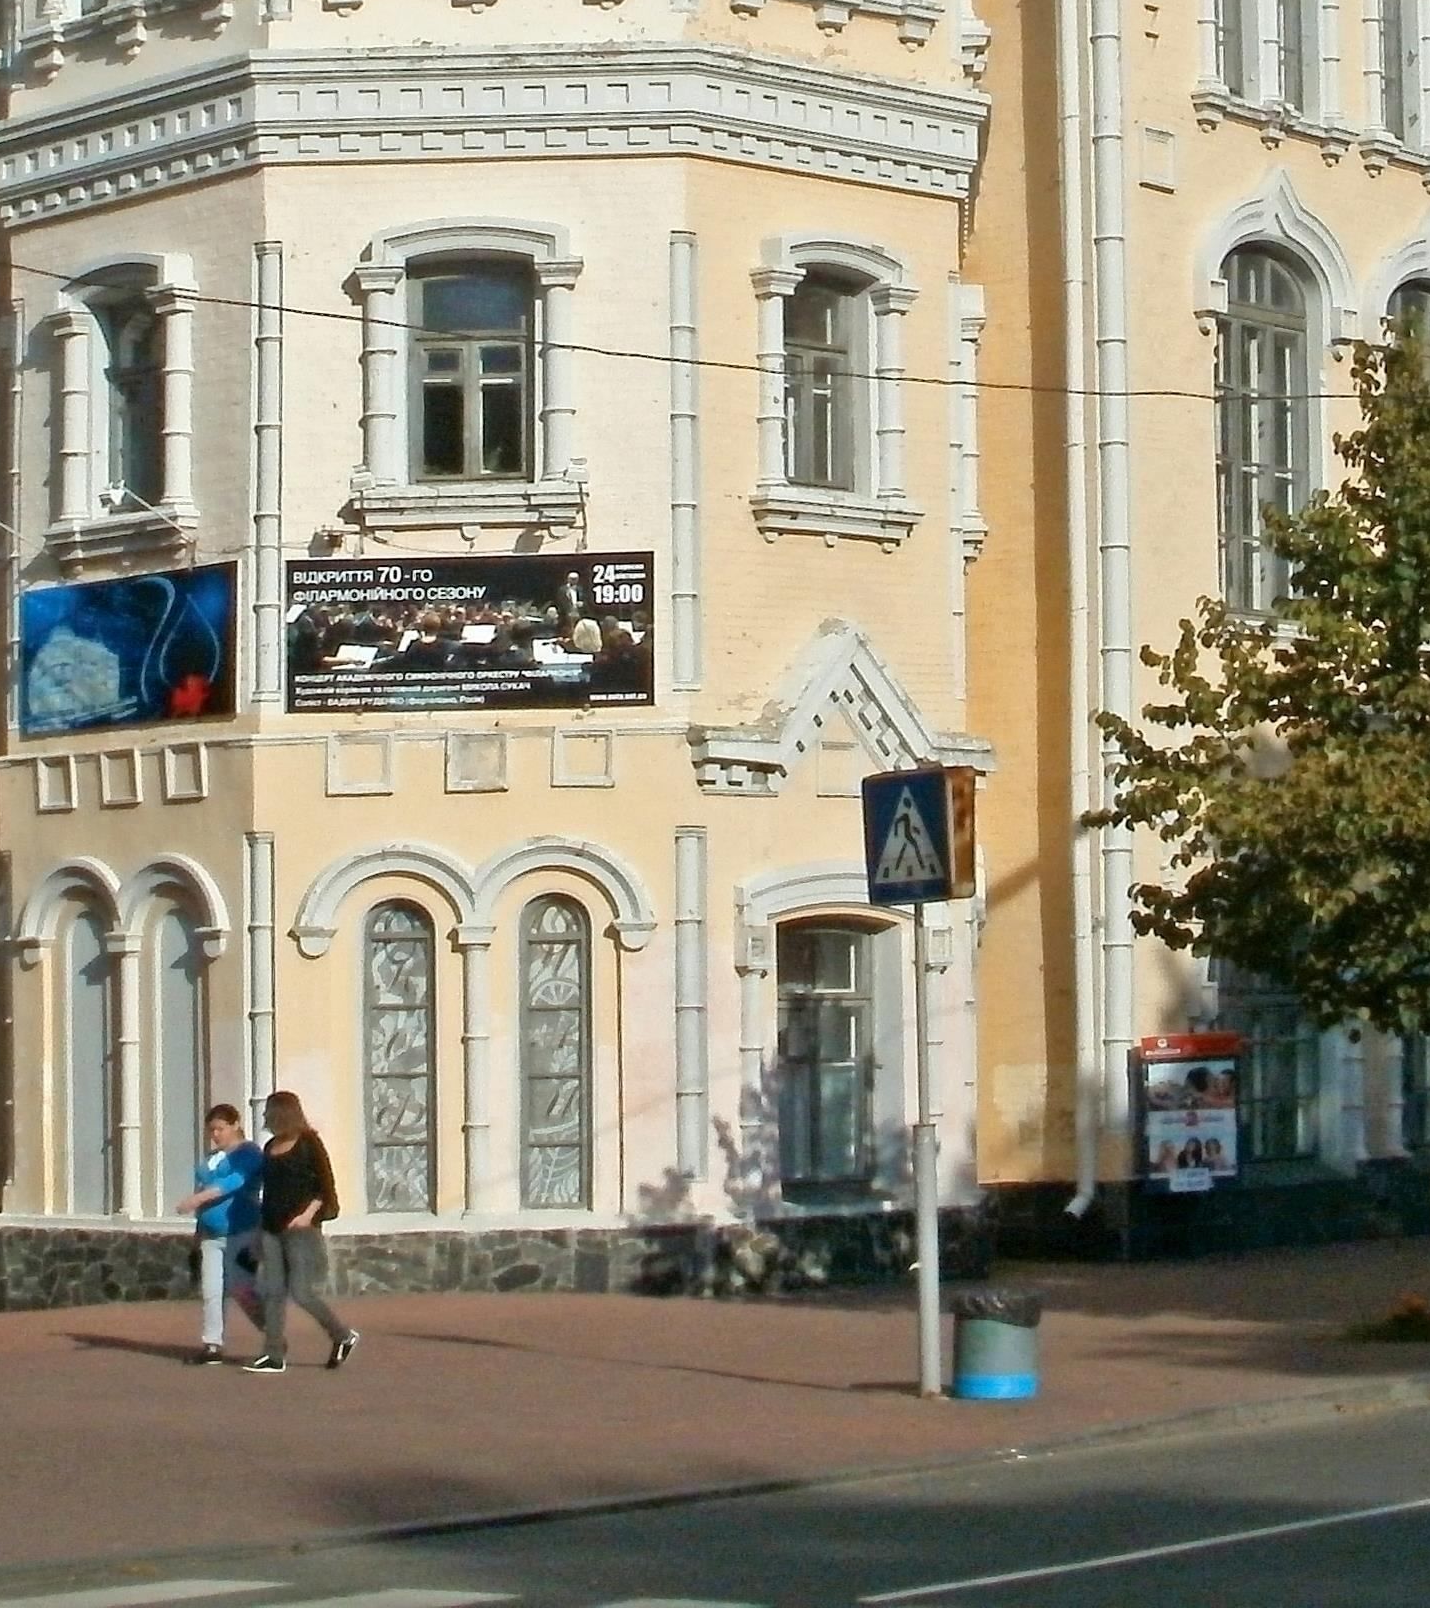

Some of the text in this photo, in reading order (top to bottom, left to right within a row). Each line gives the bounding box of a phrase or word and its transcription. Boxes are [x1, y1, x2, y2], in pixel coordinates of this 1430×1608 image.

[292, 570, 373, 585] ВІДКРИТТЯ
[377, 566, 402, 583] 70
[593, 564, 615, 583] 24
[292, 586, 487, 602] ФІЛАРМОНІЙНОГО СЕЗОНУ
[593, 584, 643, 603] 19:00
